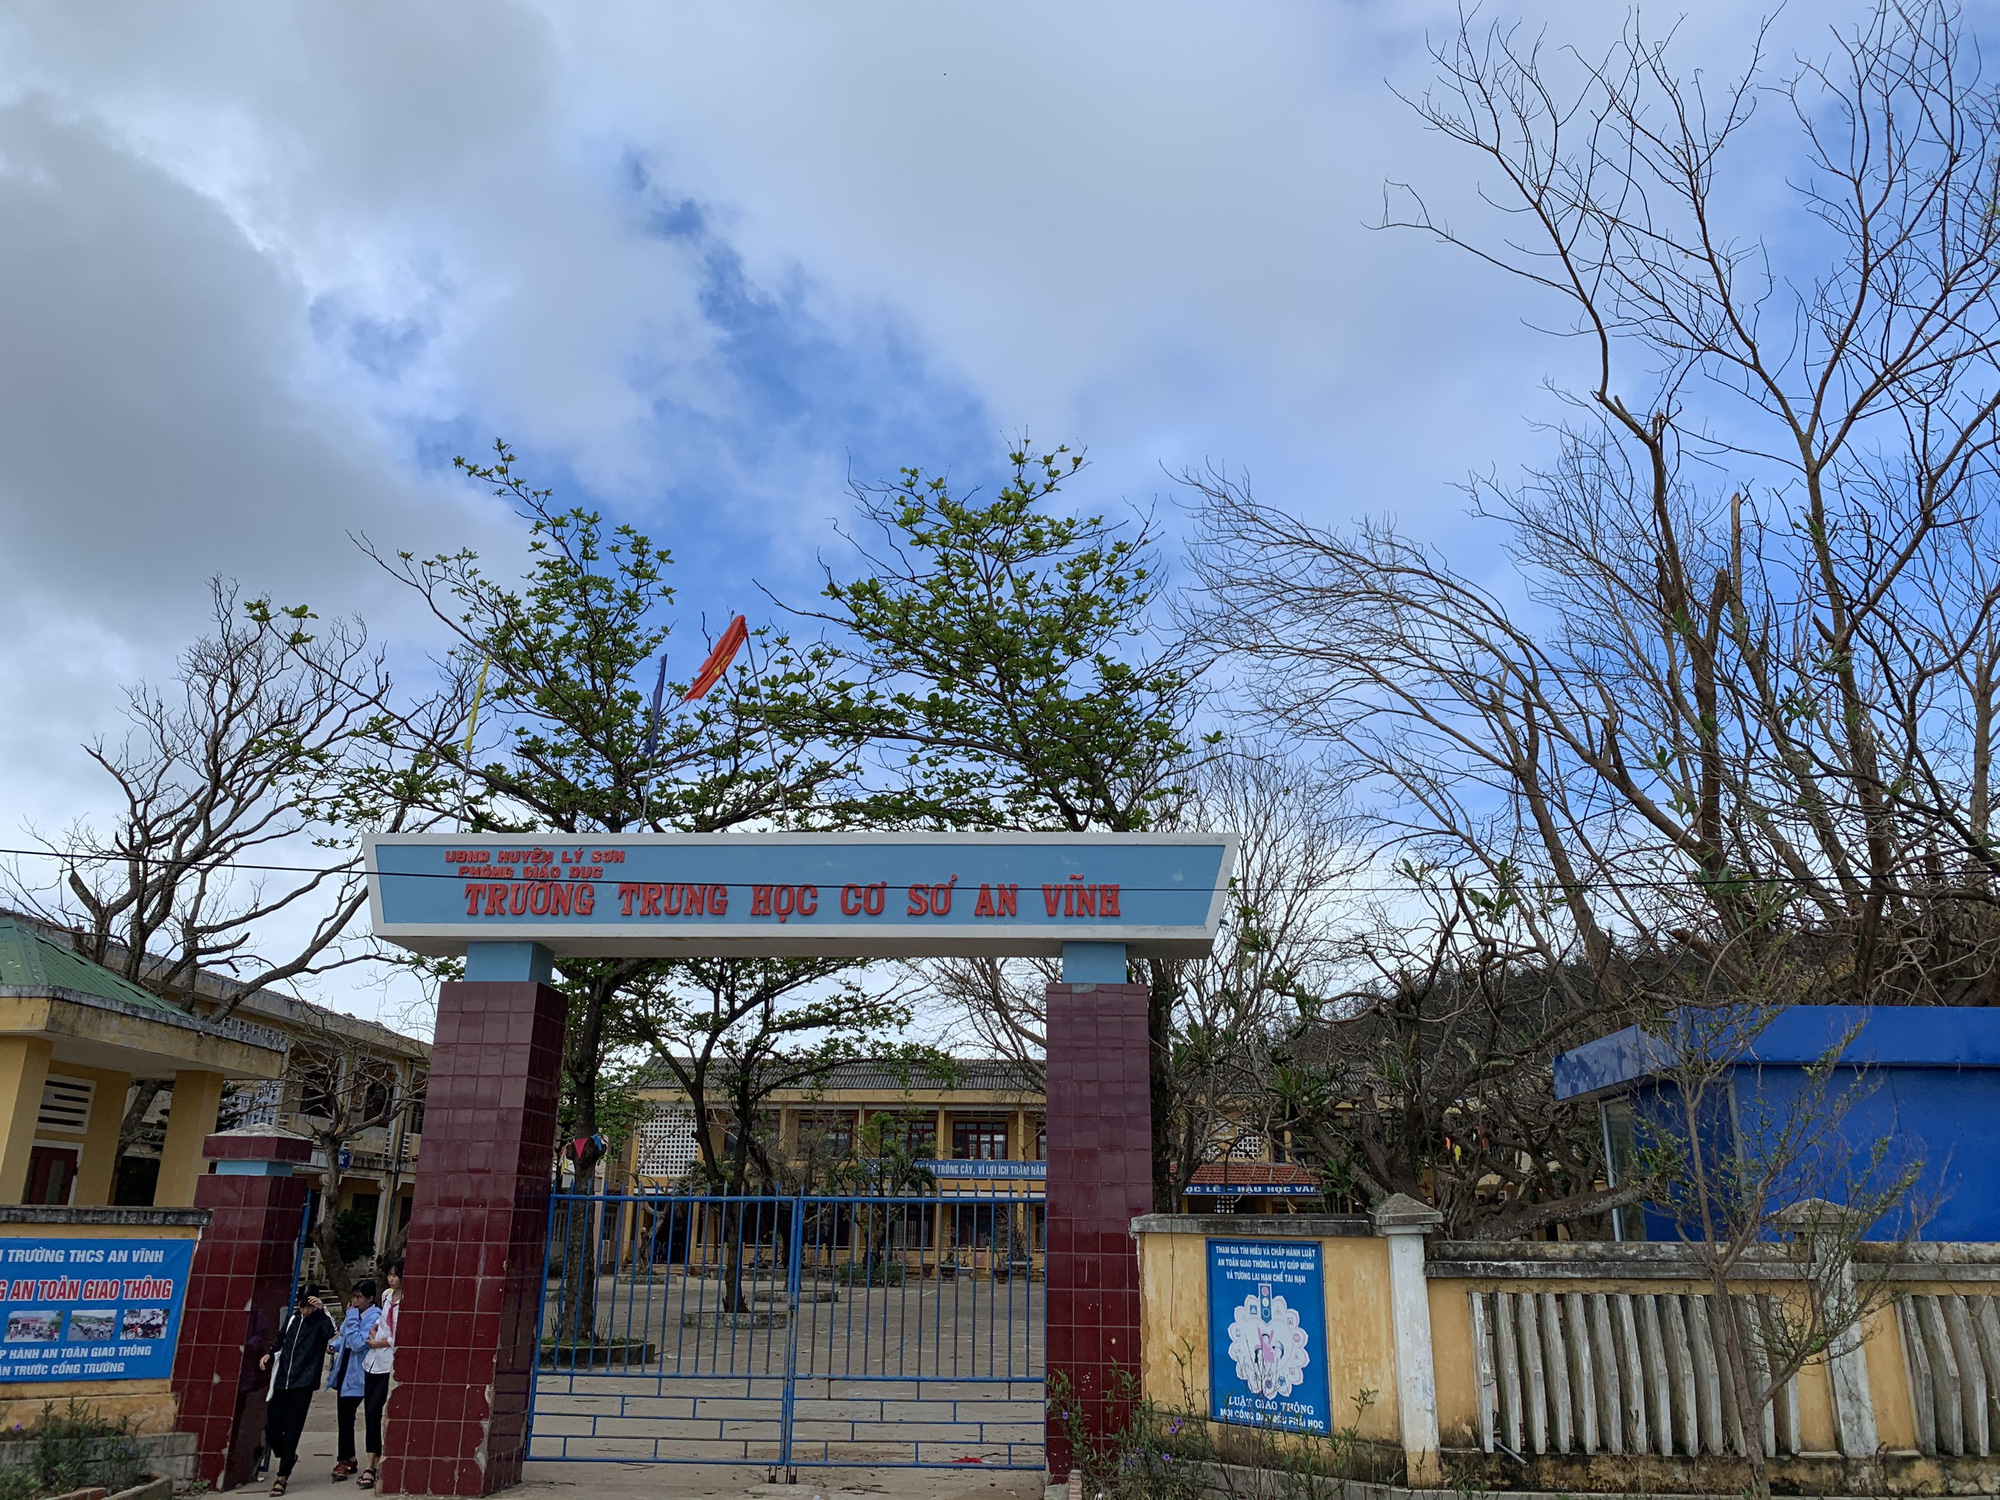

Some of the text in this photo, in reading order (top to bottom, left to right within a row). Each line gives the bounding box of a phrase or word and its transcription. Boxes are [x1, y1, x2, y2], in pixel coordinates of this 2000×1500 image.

[445, 846, 626, 866] UBND HUYỆN LÝ SƠN
[458, 862, 603, 881] PHÒNG GIÁO DỤC
[465, 873, 1120, 922] TRƯỜNG TRUNG HỌC CƠ SỞ AN VĨNH
[978, 1163, 985, 1174] VÌ
[986, 1164, 997, 1177] LỢI
[998, 1164, 1009, 1175] ÍCH
[1237, 1185, 1262, 1194] HẬU
[1267, 1186, 1291, 1194] HỌC
[8, 1246, 65, 1263] TRƯỜNG
[69, 1249, 105, 1263] THCS
[107, 1250, 128, 1263] AN
[132, 1248, 164, 1263] VĨNH
[1216, 1246, 1230, 1254] THAM
[1230, 1246, 1239, 1254] GIA
[1239, 1245, 1249, 1254] TÌM
[1263, 1245, 1270, 1256] VÀ
[1271, 1245, 1285, 1256] CHẤP
[1286, 1246, 1300, 1257] HÀNH
[1301, 1248, 1316, 1259] LUẬT
[1217, 1257, 1315, 1271] AN TOÀN GIAO THÔNG LÀ TỰ GIÚP MÌNH
[1226, 1269, 1233, 1280] VÀ
[1251, 1272, 1260, 1281] LAI
[1260, 1273, 1272, 1283] HẠN
[1272, 1271, 1284, 1282] CHẾ
[1284, 1274, 1294, 1283] TAI
[1294, 1275, 1306, 1285] NẠN
[8, 1279, 36, 1301] AN
[37, 1275, 81, 1301] TOÀN
[82, 1278, 120, 1301] GIAO
[122, 1275, 173, 1300] THÔNG
[9, 1347, 40, 1359] HÀNH
[41, 1349, 58, 1359] AN
[61, 1346, 88, 1358] TOÀN
[91, 1347, 115, 1358] GIAO
[118, 1344, 152, 1356] THÔNG
[14, 1362, 49, 1376] TRƯỚC
[84, 1361, 125, 1374] TRƯỜNG
[1255, 1398, 1278, 1410] GIAO
[1280, 1400, 1314, 1416] THÔNG
